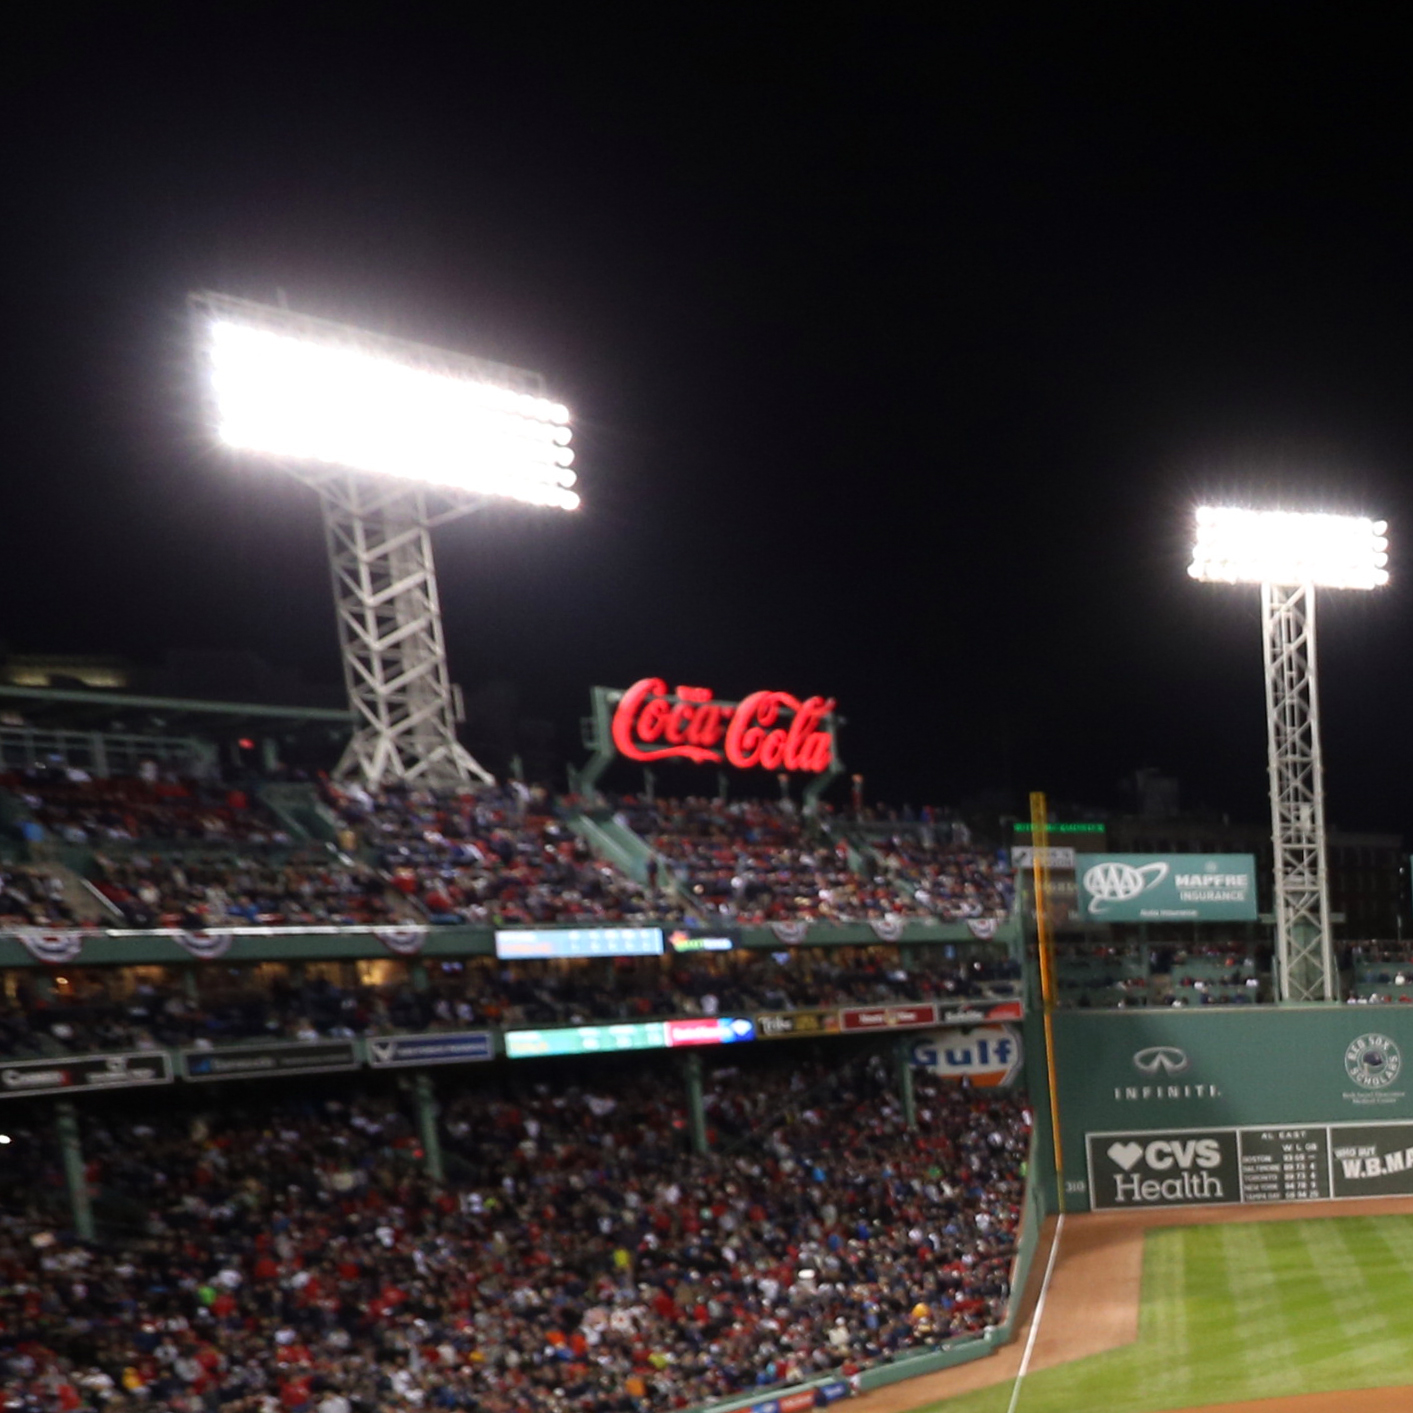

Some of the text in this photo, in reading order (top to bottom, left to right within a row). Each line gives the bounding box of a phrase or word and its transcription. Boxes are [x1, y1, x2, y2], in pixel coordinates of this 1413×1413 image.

[612, 677, 836, 772] Coca-Cola
[1090, 864, 1139, 899] AAA
[1175, 874, 1247, 886] MAPFRE
[1180, 890, 1244, 901] INSURANCE
[911, 1037, 1011, 1066] Gulf
[1347, 1035, 1390, 1061] RED SOX
[1350, 1055, 1398, 1085] SCHOLARS
[1114, 1085, 1217, 1099] INFINITI
[1279, 1131, 1306, 1139] EAST
[1145, 1138, 1222, 1170] CVS
[1113, 1170, 1224, 1202] Health
